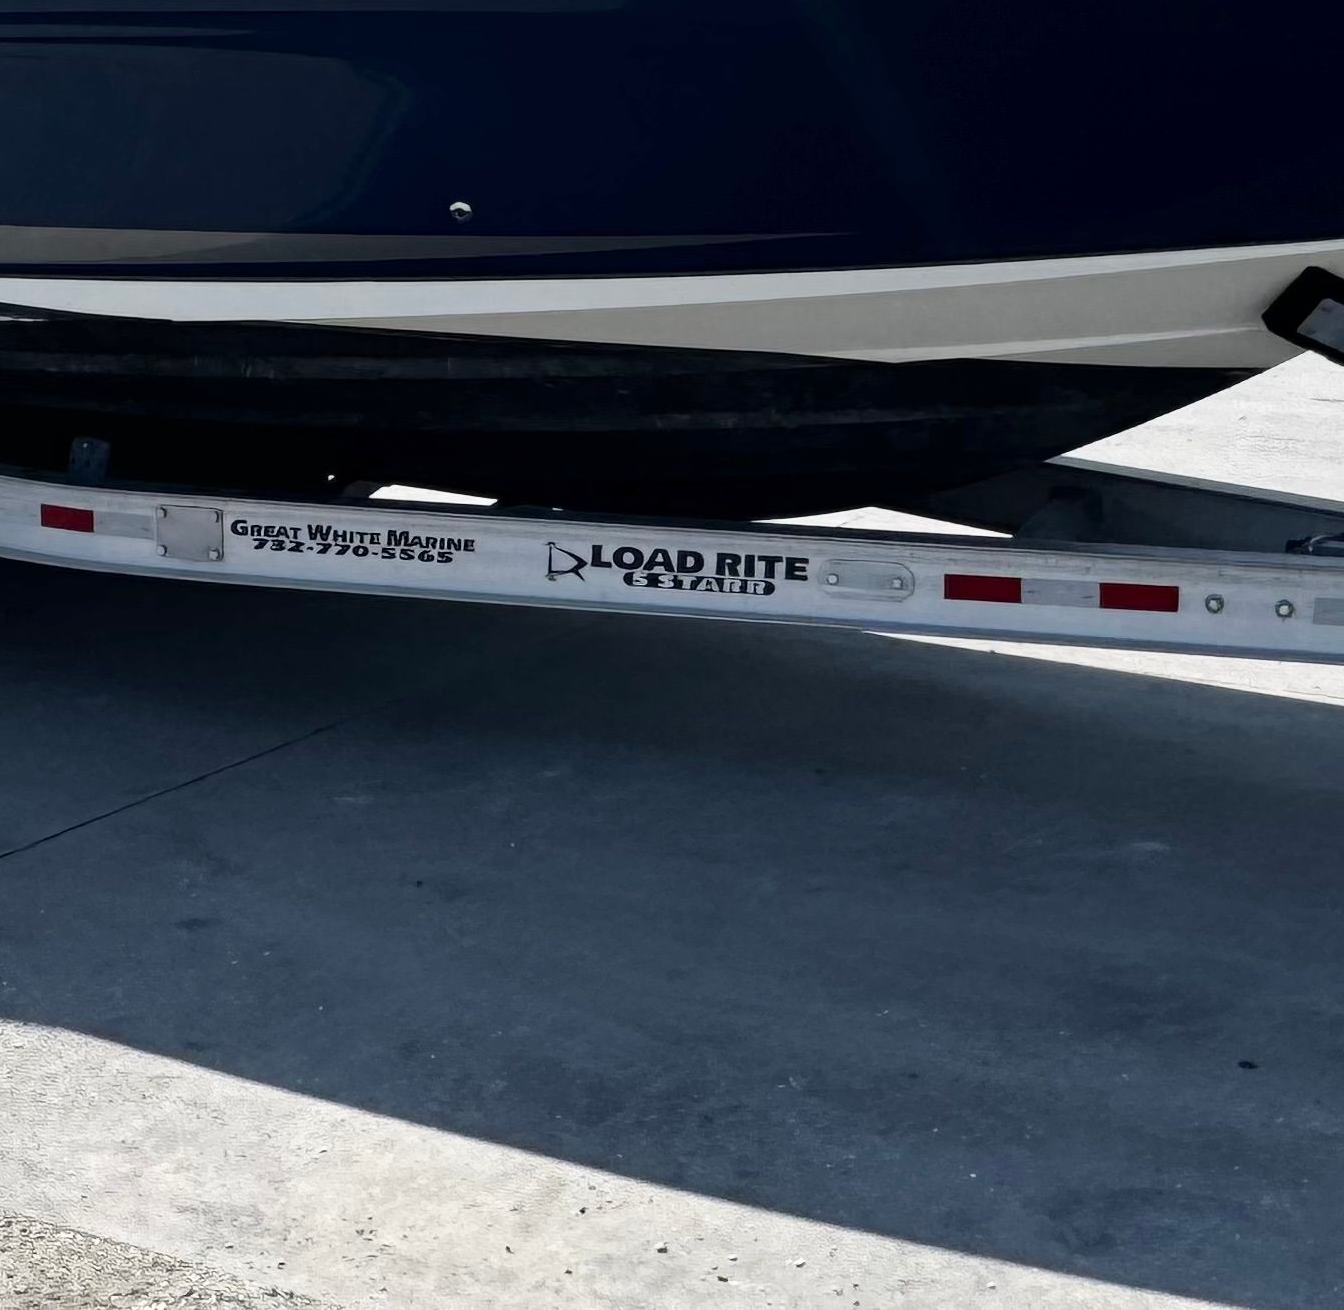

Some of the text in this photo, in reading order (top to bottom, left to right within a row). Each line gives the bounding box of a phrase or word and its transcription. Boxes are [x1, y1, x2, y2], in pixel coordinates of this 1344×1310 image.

[253, 538, 454, 564] 732-770-5565
[590, 544, 810, 581] LOAD RITE
[632, 574, 767, 595] 5 STARR
